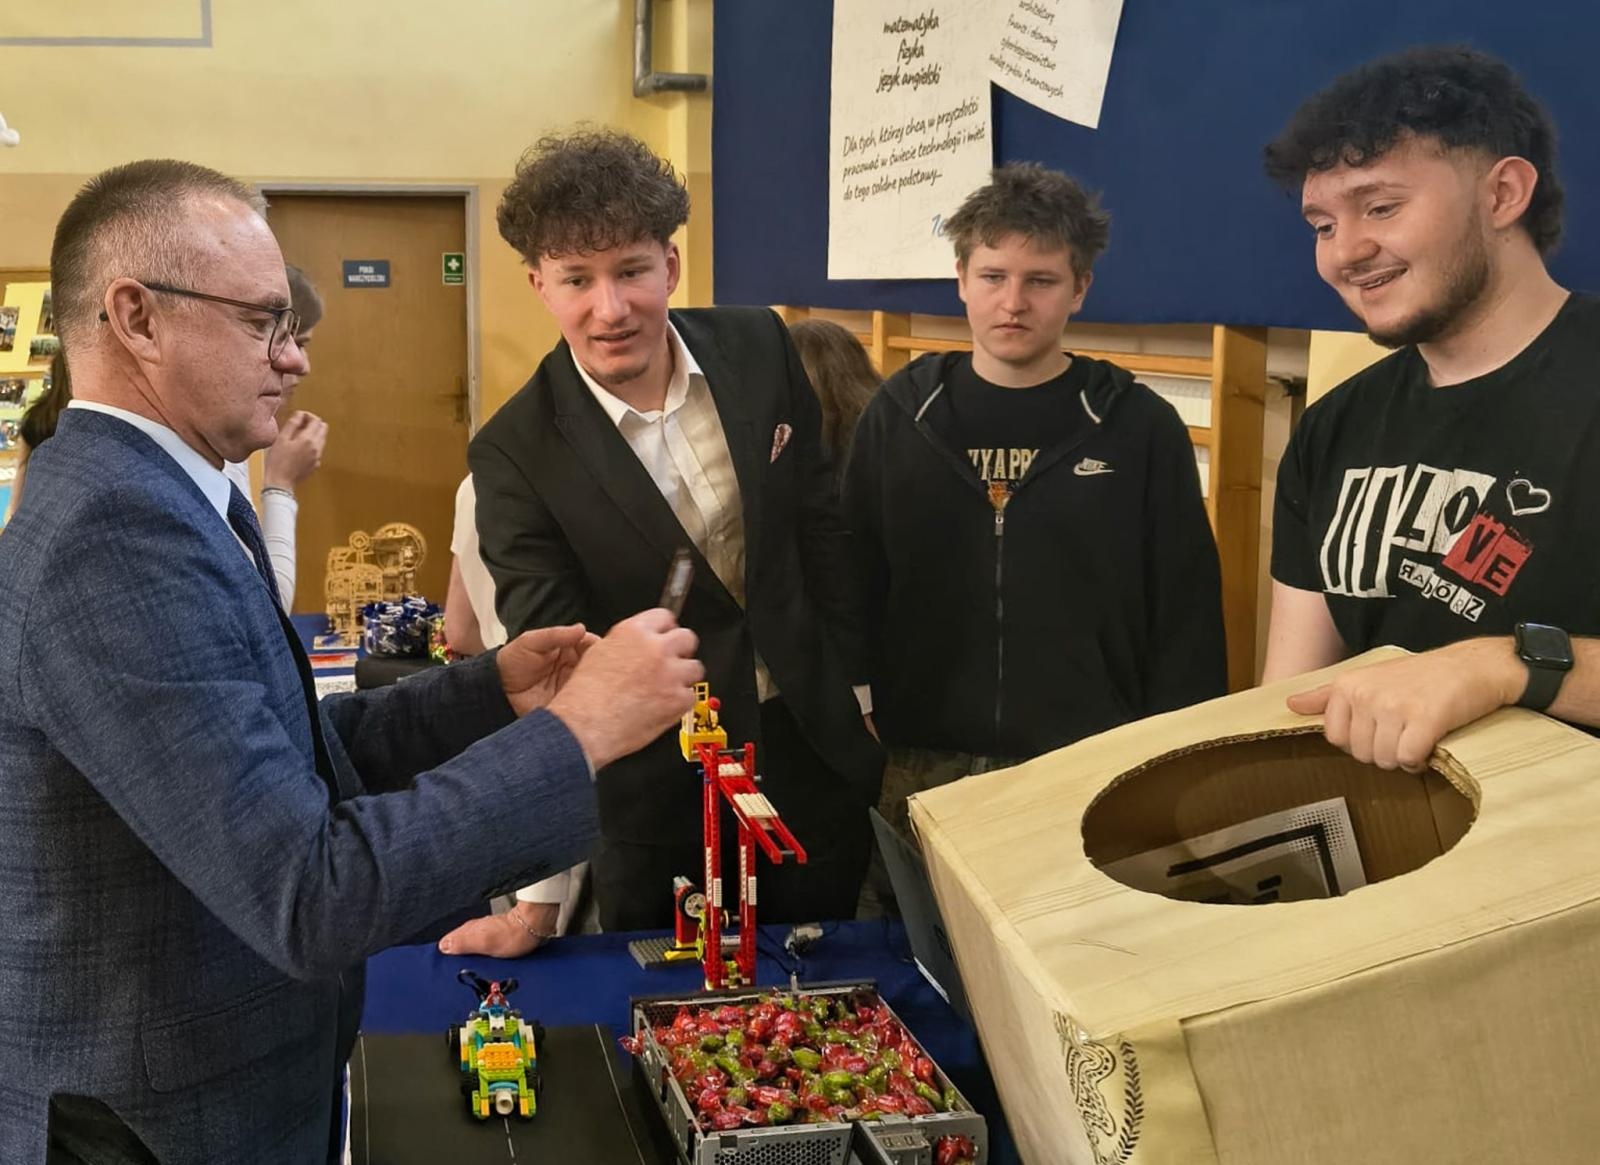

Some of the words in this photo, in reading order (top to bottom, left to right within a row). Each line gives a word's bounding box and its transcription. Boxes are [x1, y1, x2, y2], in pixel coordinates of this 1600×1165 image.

[883, 8, 940, 37] matematyka
[897, 37, 924, 65] fizyka
[876, 65, 900, 93] język
[901, 62, 941, 91] angielski
[843, 135, 857, 157] Dla
[879, 125, 904, 144] którzy
[905, 117, 926, 135] chcą
[927, 118, 936, 128] w
[936, 96, 979, 132] przyszłości
[843, 153, 880, 183] pracować
[889, 148, 916, 166] świecie
[918, 130, 962, 157] technologii
[843, 184, 853, 200] do
[855, 184, 870, 202] tego
[872, 174, 897, 195] solidne
